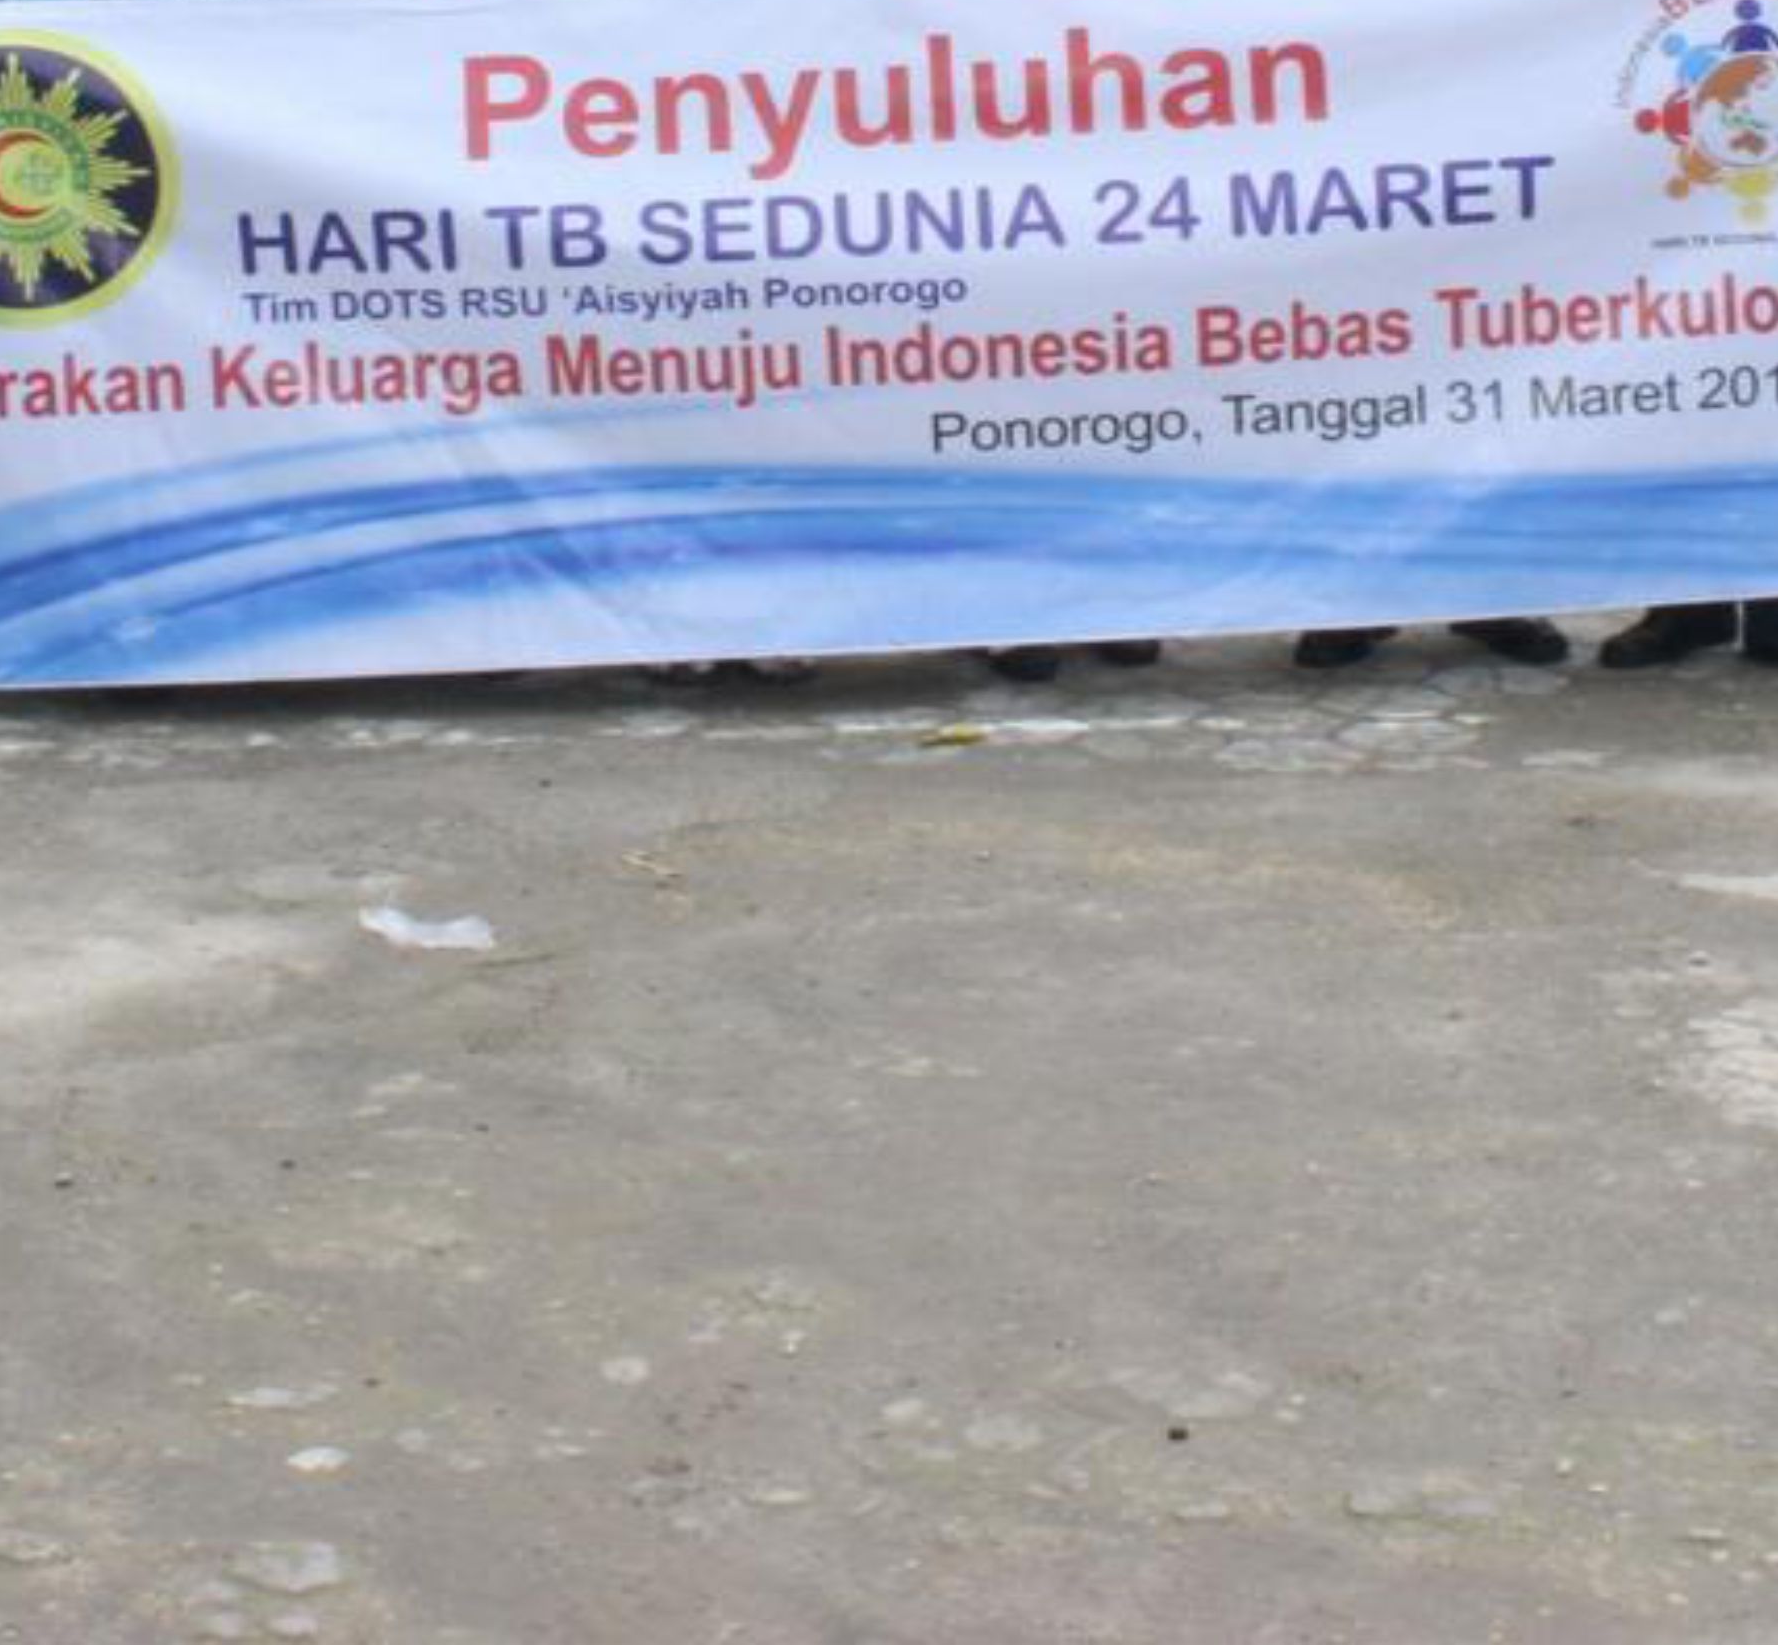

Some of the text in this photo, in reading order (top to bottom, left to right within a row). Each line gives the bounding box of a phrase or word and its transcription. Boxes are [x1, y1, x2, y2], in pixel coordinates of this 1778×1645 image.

[462, 26, 1329, 181] Penyuluhan
[239, 156, 1555, 275] HARI TB SEDUNIA 24 MARET
[242, 292, 319, 324] Tim
[331, 287, 445, 322] DOTS
[461, 285, 548, 319] RSU
[764, 275, 969, 310] Ponorogo
[211, 341, 522, 414] Keluarga
[545, 328, 800, 408] Menuju
[825, 311, 1171, 386] Indonesia
[1196, 300, 1413, 366] Bebas
[931, 407, 1204, 454] Ponorogo,
[1222, 383, 1427, 441] Tanggal
[1447, 380, 1504, 424] 31
[1529, 368, 1680, 421] Maret
